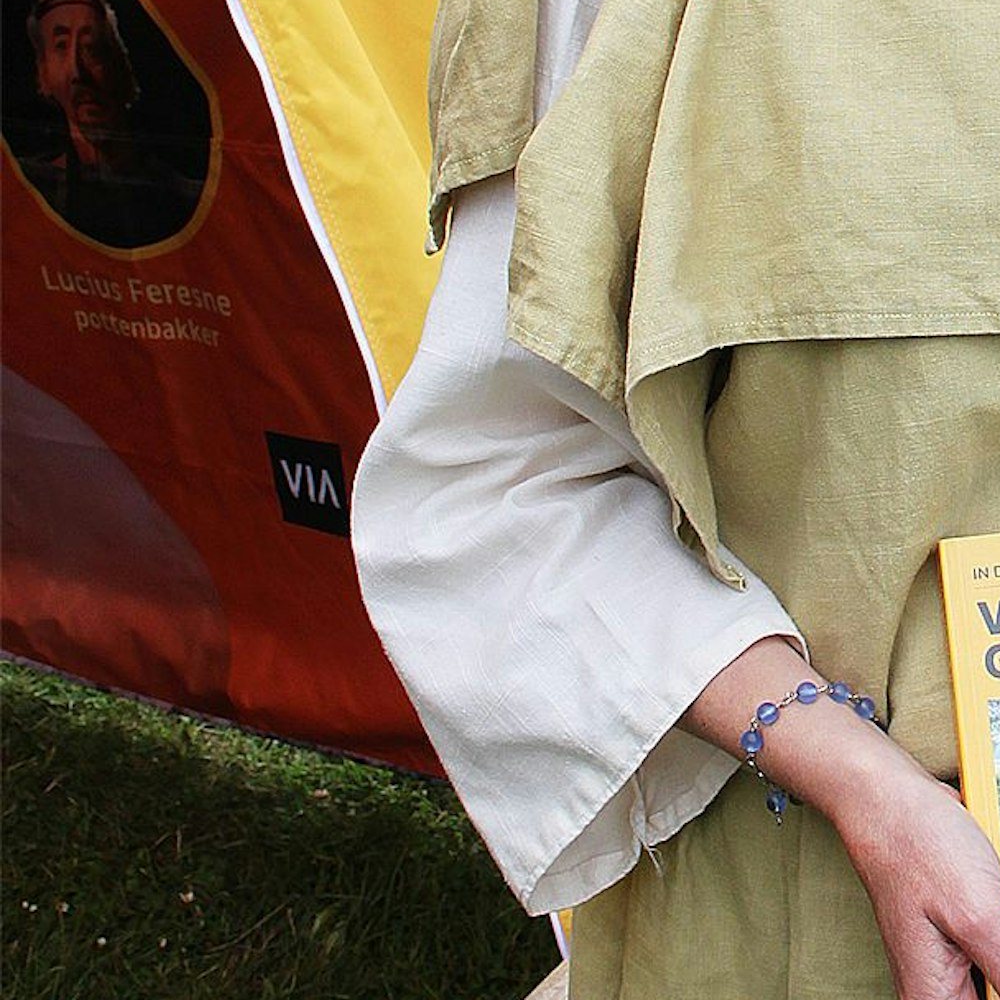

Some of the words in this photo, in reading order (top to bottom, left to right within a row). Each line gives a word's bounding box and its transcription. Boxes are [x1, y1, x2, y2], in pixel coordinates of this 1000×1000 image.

[41, 265, 122, 302] Lucius
[75, 310, 221, 348] pottenbakker
[280, 459, 341, 509] VIA
[973, 566, 989, 580] IN
